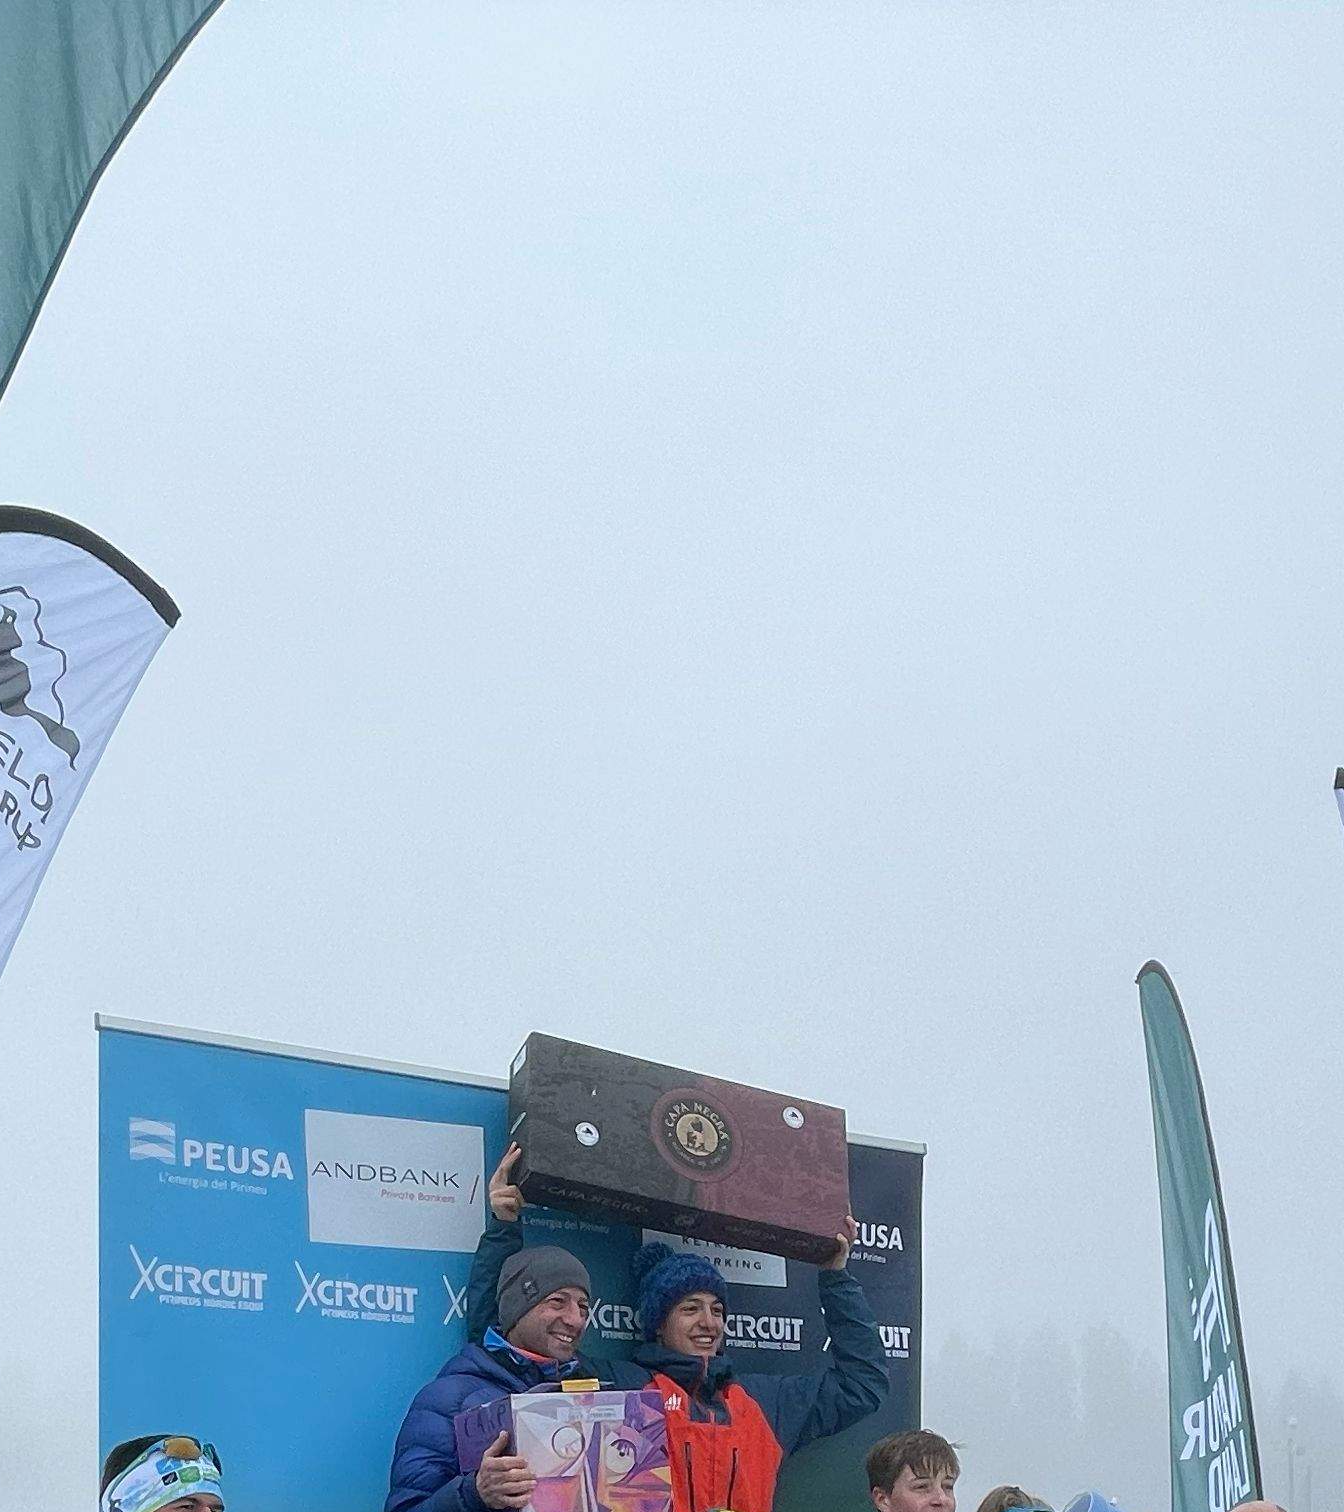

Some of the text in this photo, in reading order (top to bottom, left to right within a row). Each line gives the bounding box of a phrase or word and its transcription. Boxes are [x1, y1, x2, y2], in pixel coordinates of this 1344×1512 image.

[182, 1138, 295, 1181] PEUSA
[311, 1160, 460, 1190] ANDBANK
[380, 1189, 415, 1201] Private
[854, 1221, 904, 1251] EUSA
[724, 1313, 804, 1342] CiRCUiT
